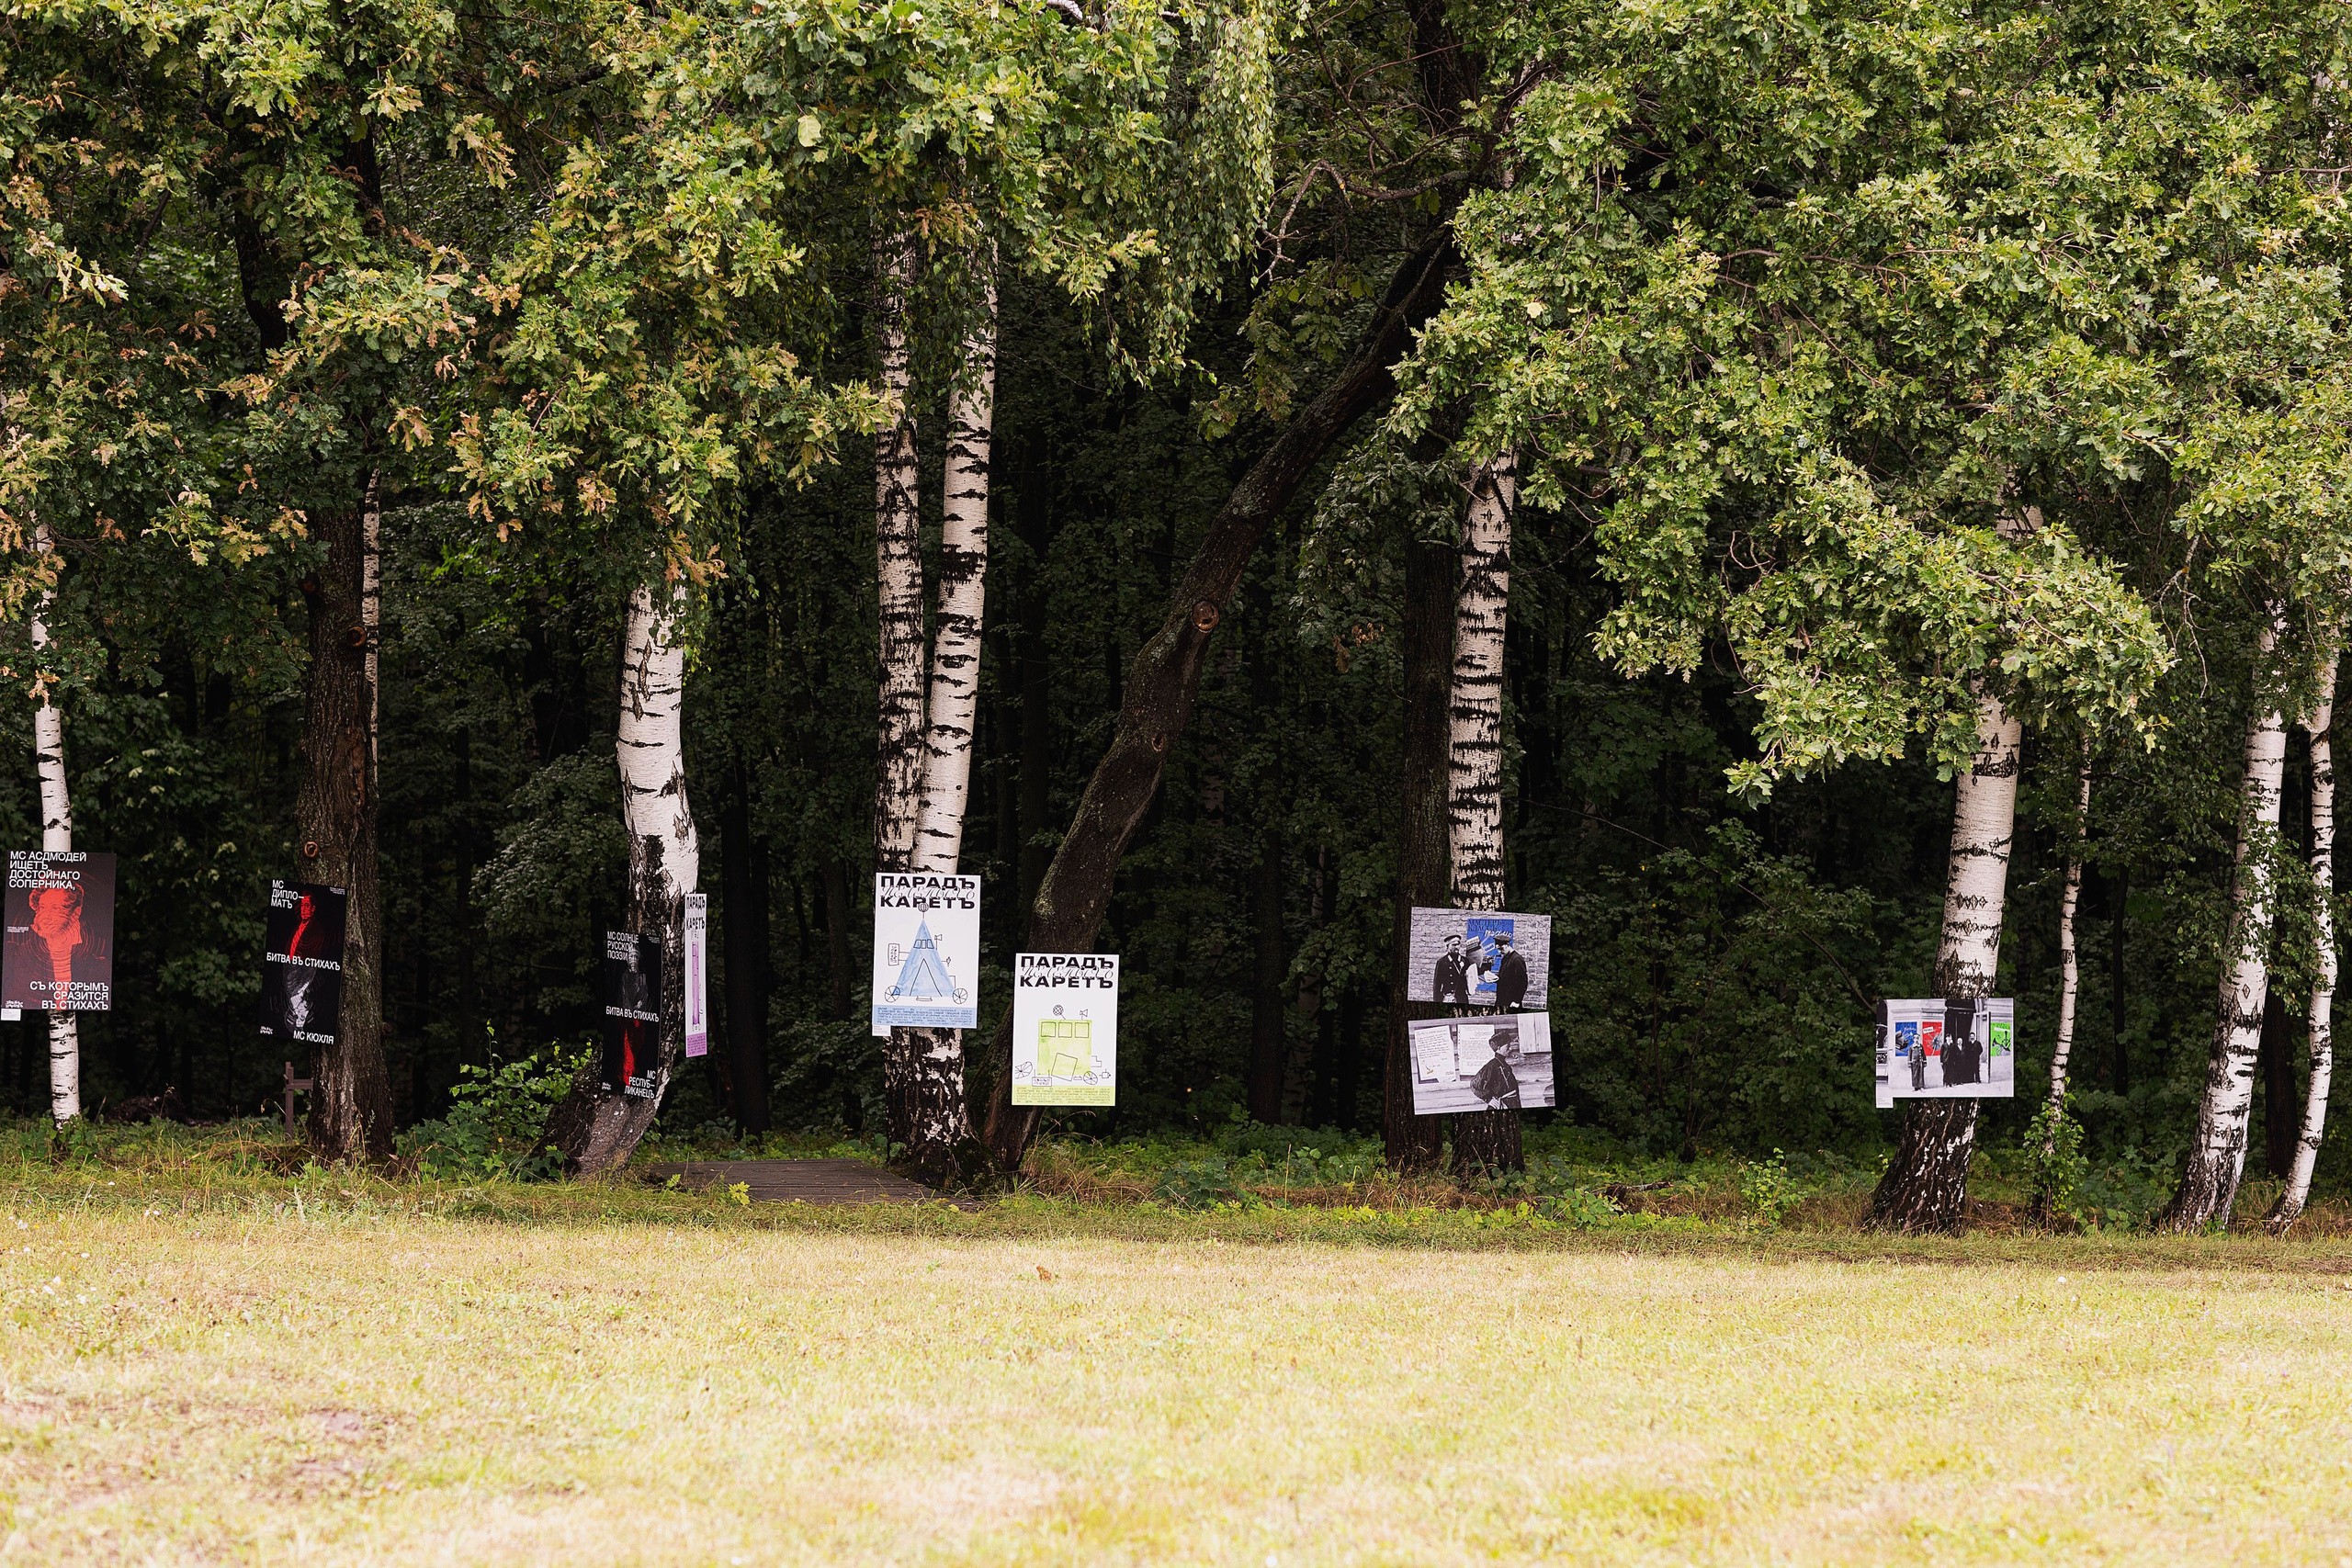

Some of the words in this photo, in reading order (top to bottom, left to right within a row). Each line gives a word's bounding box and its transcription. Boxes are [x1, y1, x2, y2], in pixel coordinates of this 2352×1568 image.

[10, 851, 27, 860] МС
[28, 852, 87, 863] АСДМОДЕЙ
[9, 860, 49, 870] ИЩЕТЪ
[9, 869, 81, 880] ДОСТОЙНАГО
[8, 879, 75, 890] СОПЕРНИКА,
[272, 879, 285, 889] МС
[881, 875, 976, 890] ПАРАДЪ
[270, 898, 293, 909] МАТЪ
[685, 896, 706, 910] ПАРАДЪ
[880, 897, 976, 909] КАРЕТЪ
[606, 931, 616, 941] МС
[616, 932, 639, 944] СОЛНЦЕ
[266, 952, 291, 964] БИТВА
[291, 955, 304, 965] ВЪ
[304, 957, 341, 971] СТИХАХЪ
[1021, 956, 1114, 970] ПАРАДЪ
[29, 981, 47, 990] СЪ
[49, 981, 109, 992] КОТОРЫМЪ
[1020, 976, 1114, 988] КАРЕТЪ
[53, 991, 108, 1000] СРАЗИТСЯ
[41, 999, 57, 1010] ВЪ
[59, 1000, 108, 1010] СТИХАХЪ
[605, 1006, 624, 1017] БИТВА
[625, 1009, 633, 1019] ВЪ
[633, 1010, 660, 1022] СТИХАХЪ
[293, 1030, 306, 1041] МС
[306, 1032, 334, 1045] КЮХЛЯ
[647, 1069, 656, 1080] МС
[624, 1085, 655, 1100] ЛИКАНЕЦЪ
